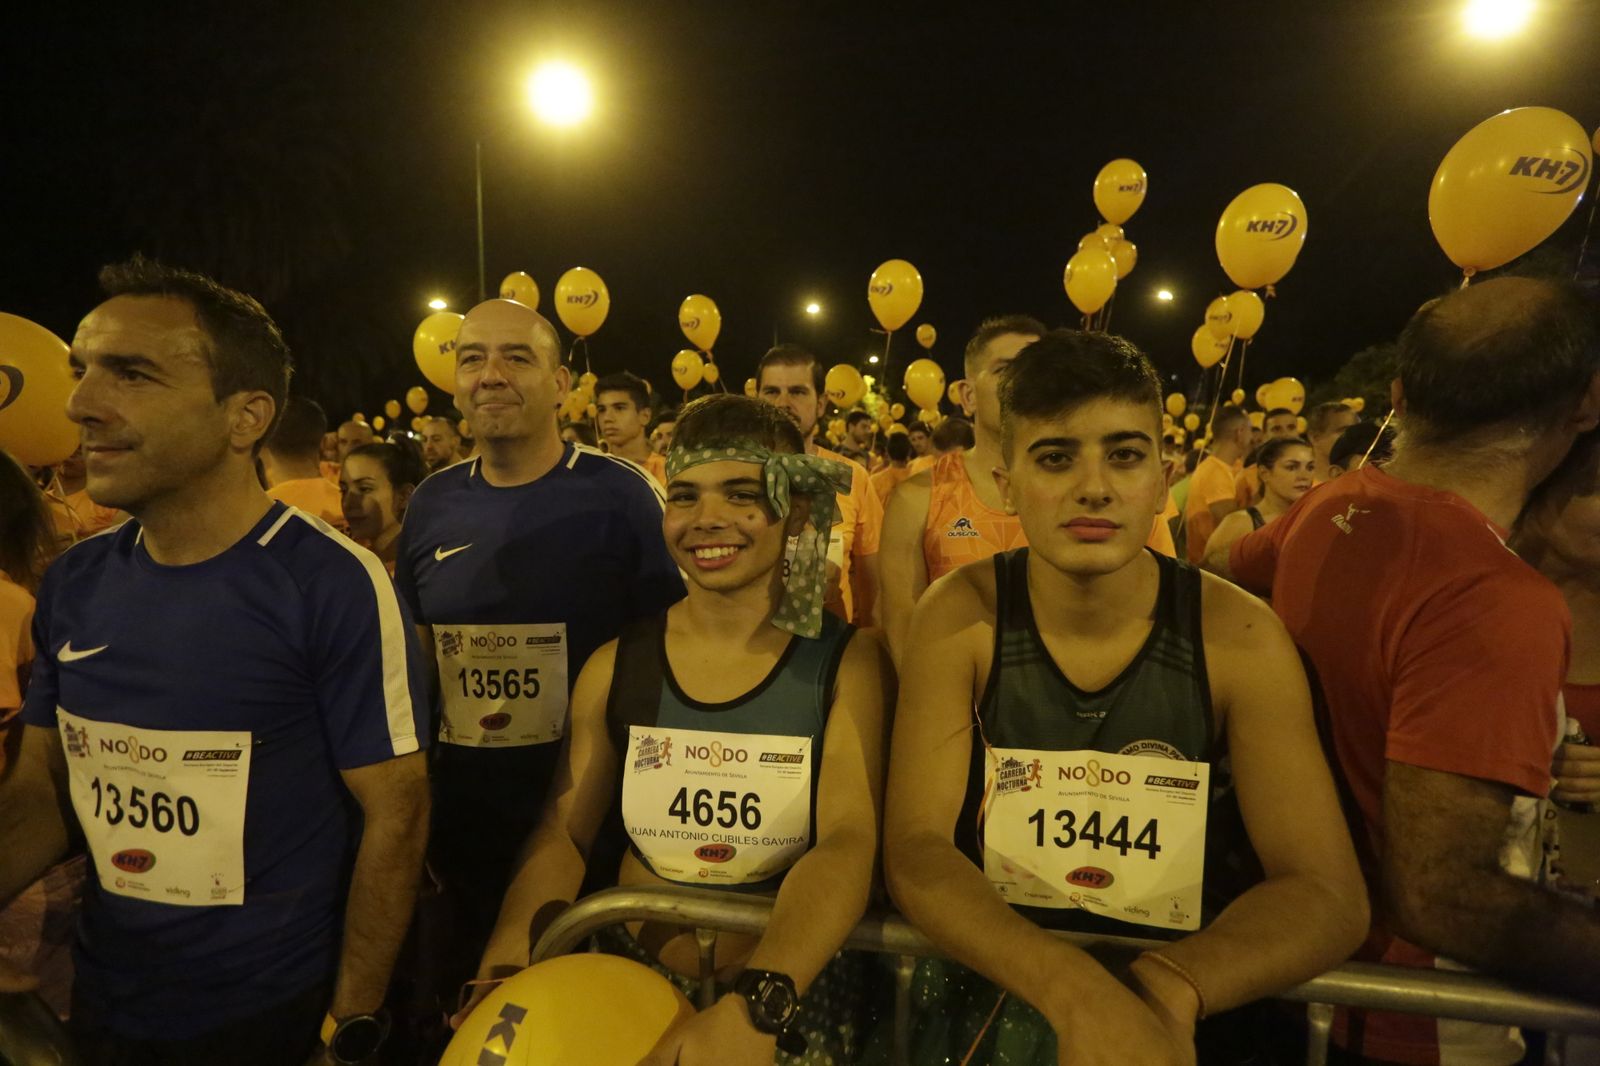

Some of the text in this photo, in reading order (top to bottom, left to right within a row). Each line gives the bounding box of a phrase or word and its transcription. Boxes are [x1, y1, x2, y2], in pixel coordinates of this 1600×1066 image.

[458, 668, 540, 699] 13565
[1140, 742, 1168, 753] DIVINA
[184, 751, 241, 761] #BEACTIVE
[760, 753, 803, 763] #BEACTIVE
[1000, 767, 1026, 780] CARRERA
[997, 779, 1028, 791] NOCTURNA
[1146, 776, 1198, 789] #BEACTIVE
[91, 776, 200, 836] 13560
[668, 787, 762, 830] 4656
[629, 827, 805, 846] JUAN ANTONIO CUBILES GAVIRA
[1028, 809, 1161, 859] 13444
[1123, 905, 1150, 917] viding
